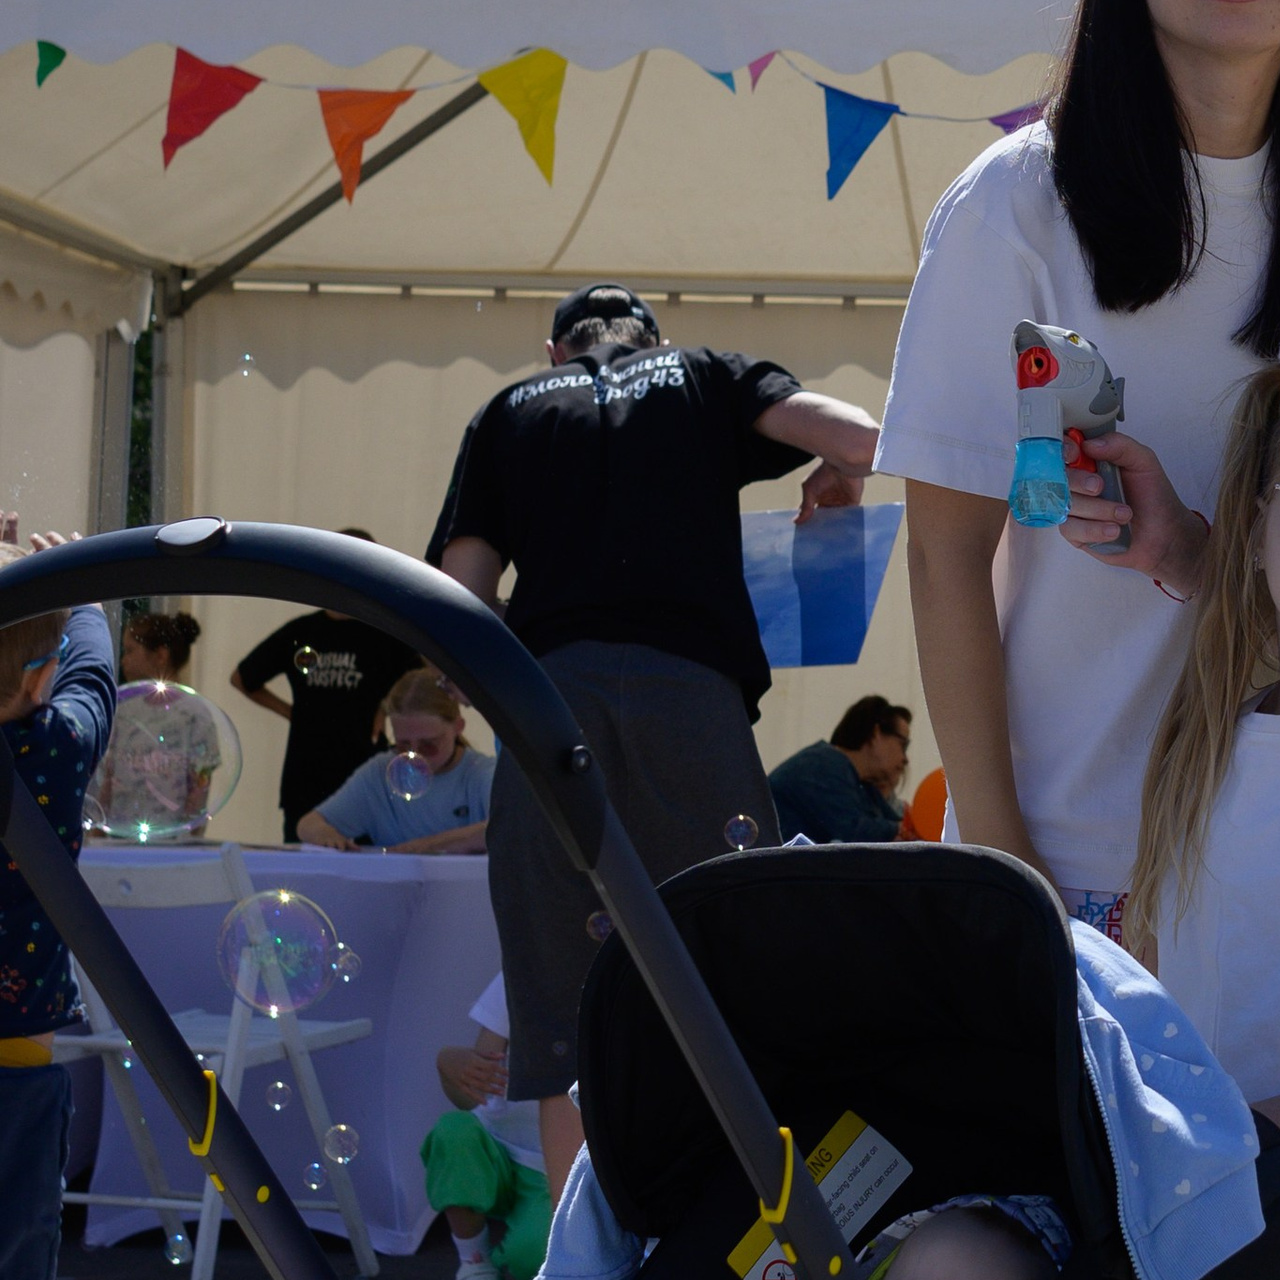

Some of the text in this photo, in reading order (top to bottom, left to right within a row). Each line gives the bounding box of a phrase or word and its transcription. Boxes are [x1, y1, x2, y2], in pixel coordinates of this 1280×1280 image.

[307, 667, 363, 690] SUSPECT
[807, 1147, 833, 1179] ING
[826, 1145, 879, 1208] ar-facing child seat on
[852, 1184, 875, 1212] INJURY
[873, 1175, 886, 1188] can
[883, 1158, 900, 1177] occur
